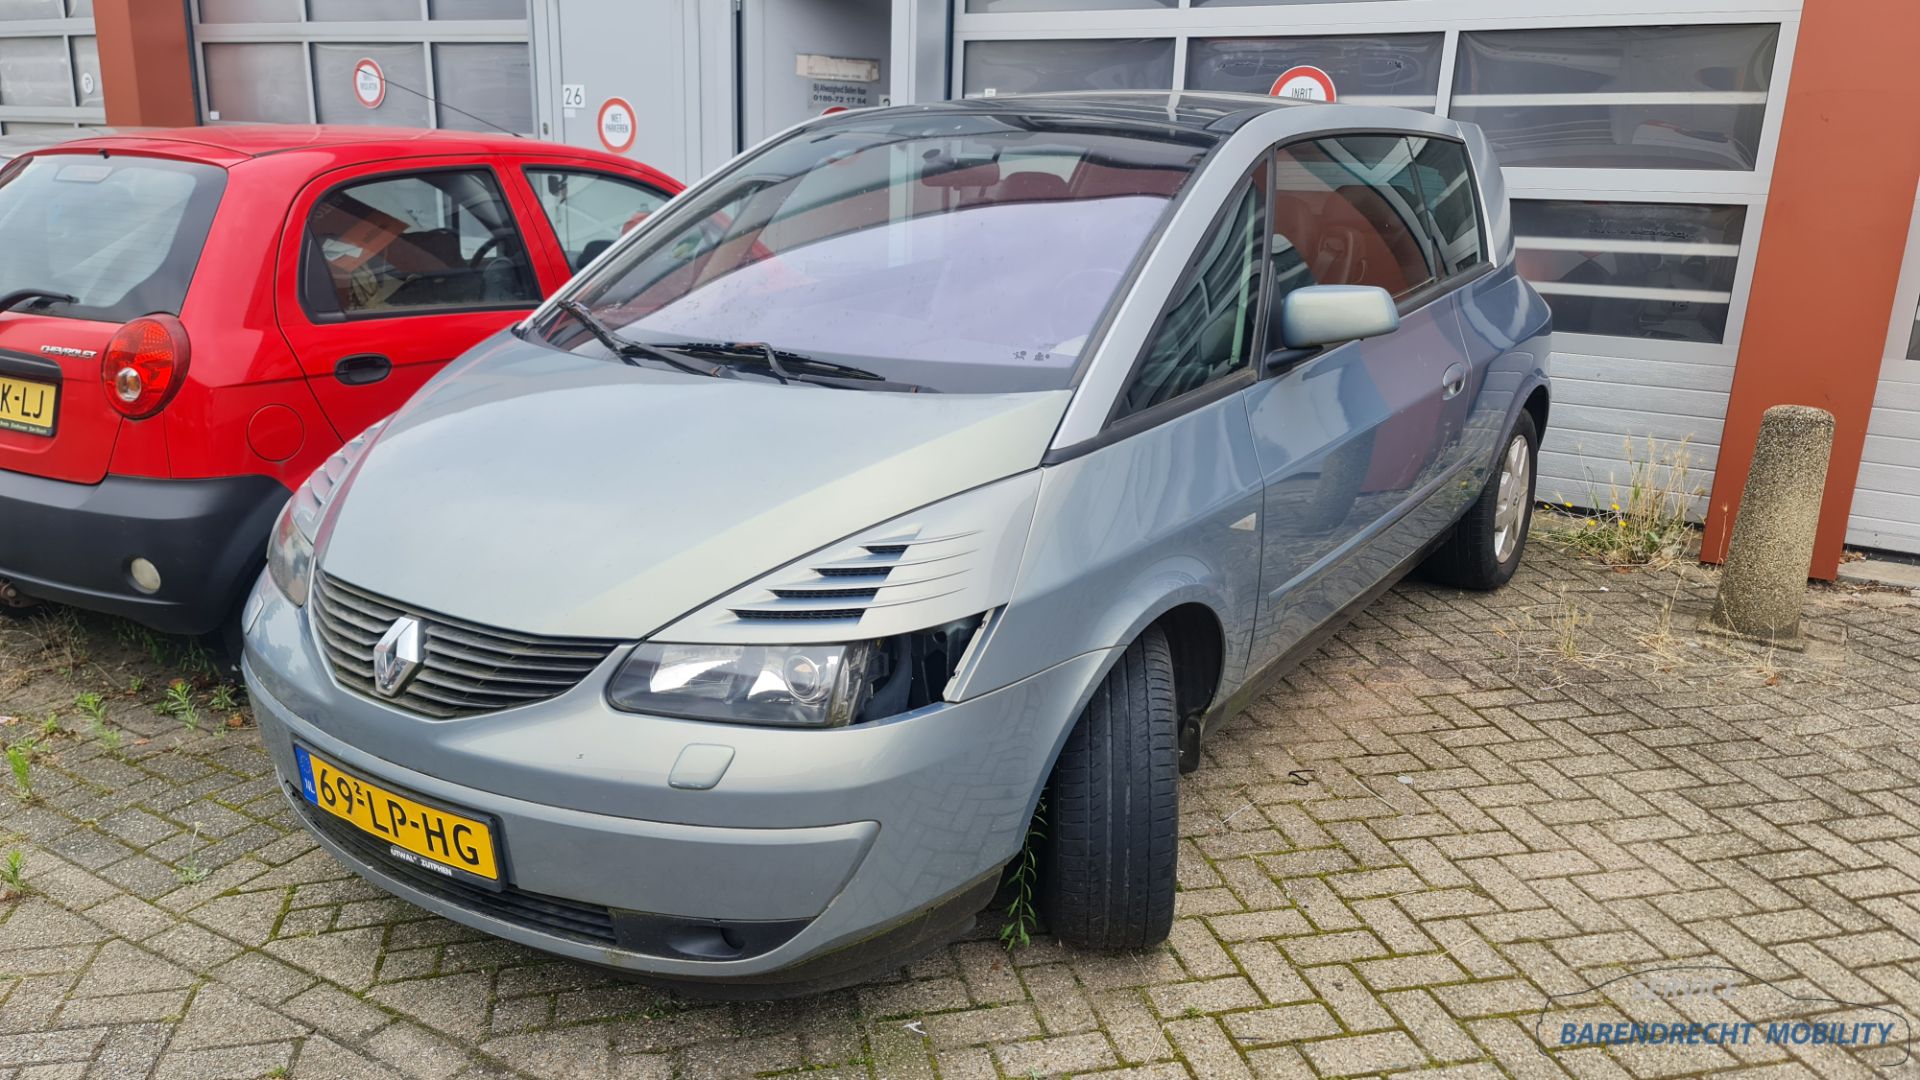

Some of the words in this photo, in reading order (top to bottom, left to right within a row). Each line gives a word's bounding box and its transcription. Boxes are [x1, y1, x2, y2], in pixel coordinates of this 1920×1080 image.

[565, 88, 582, 105] 26
[1291, 87, 1313, 99] INRIT
[40, 345, 97, 358] CHEVROLET
[0, 383, 44, 419] K-LJ
[304, 778, 316, 794] NL
[420, 858, 452, 877] ZUTPHEN
